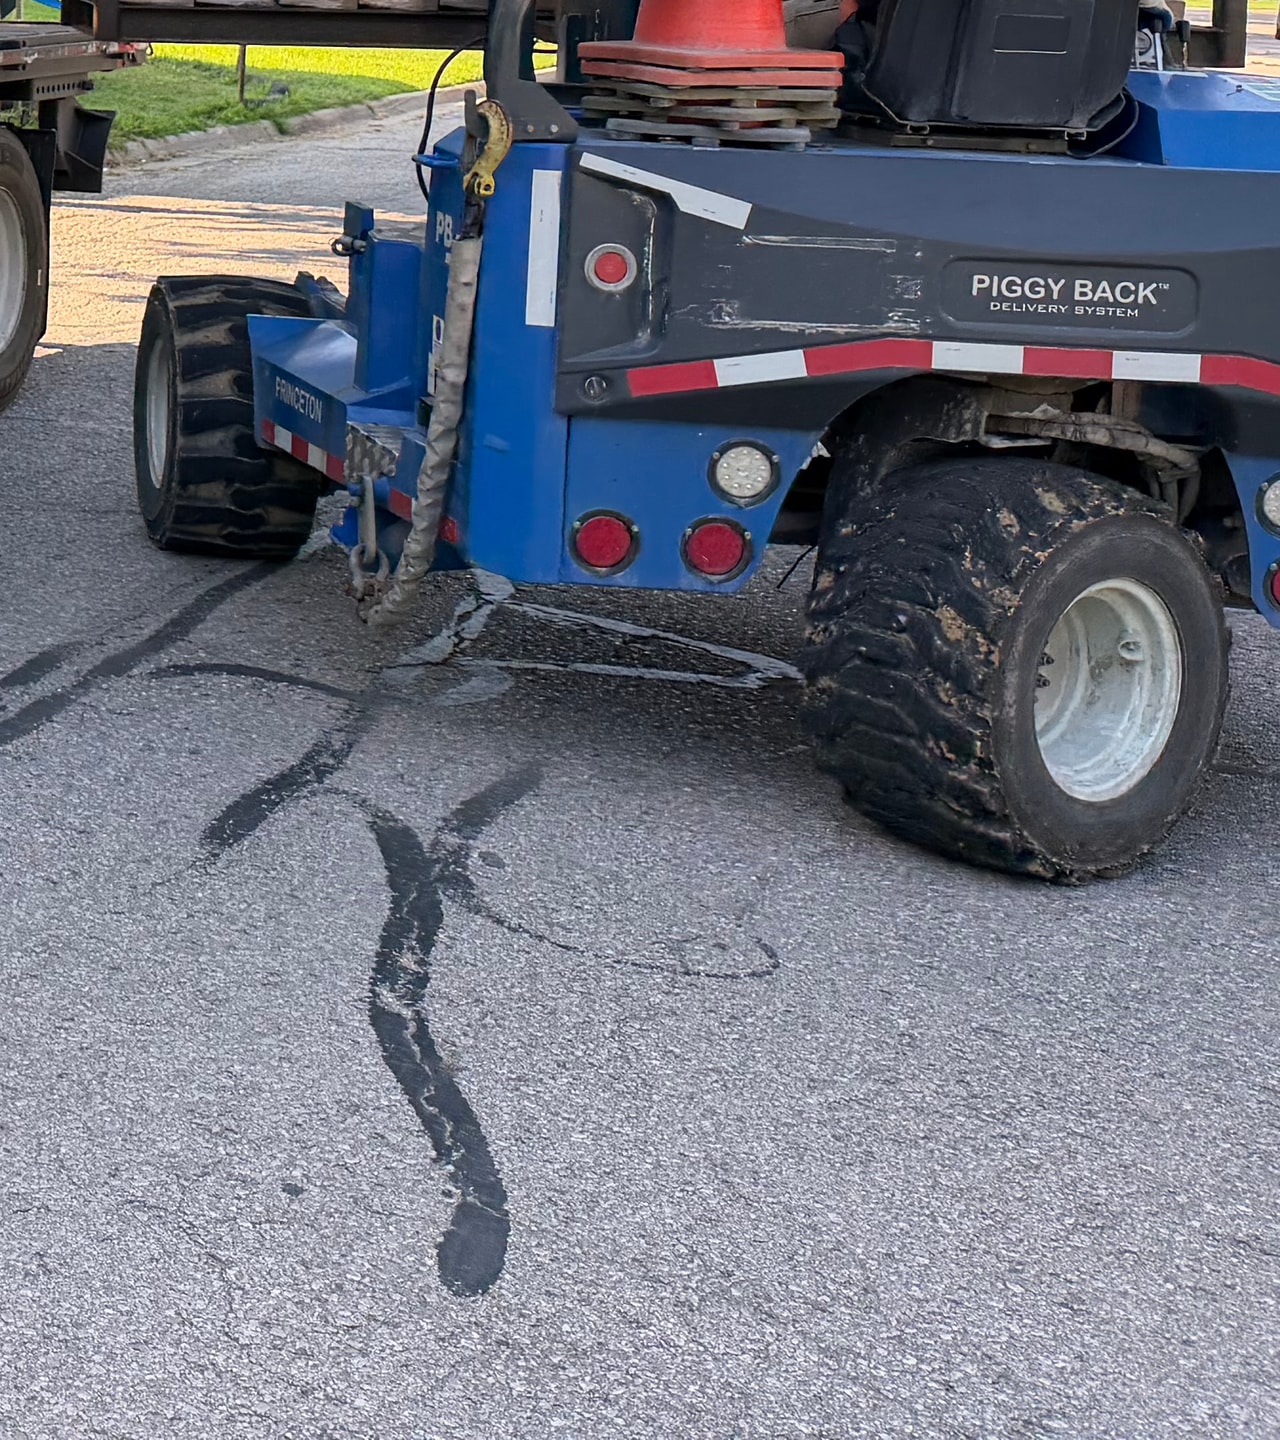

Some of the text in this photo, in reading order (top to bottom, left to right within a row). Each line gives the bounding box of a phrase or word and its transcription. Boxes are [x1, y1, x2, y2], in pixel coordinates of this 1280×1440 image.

[971, 274, 1066, 300] PIGGY
[990, 301, 1139, 318] DELIVERY SYSTEM
[275, 375, 323, 424] PRINCETON
